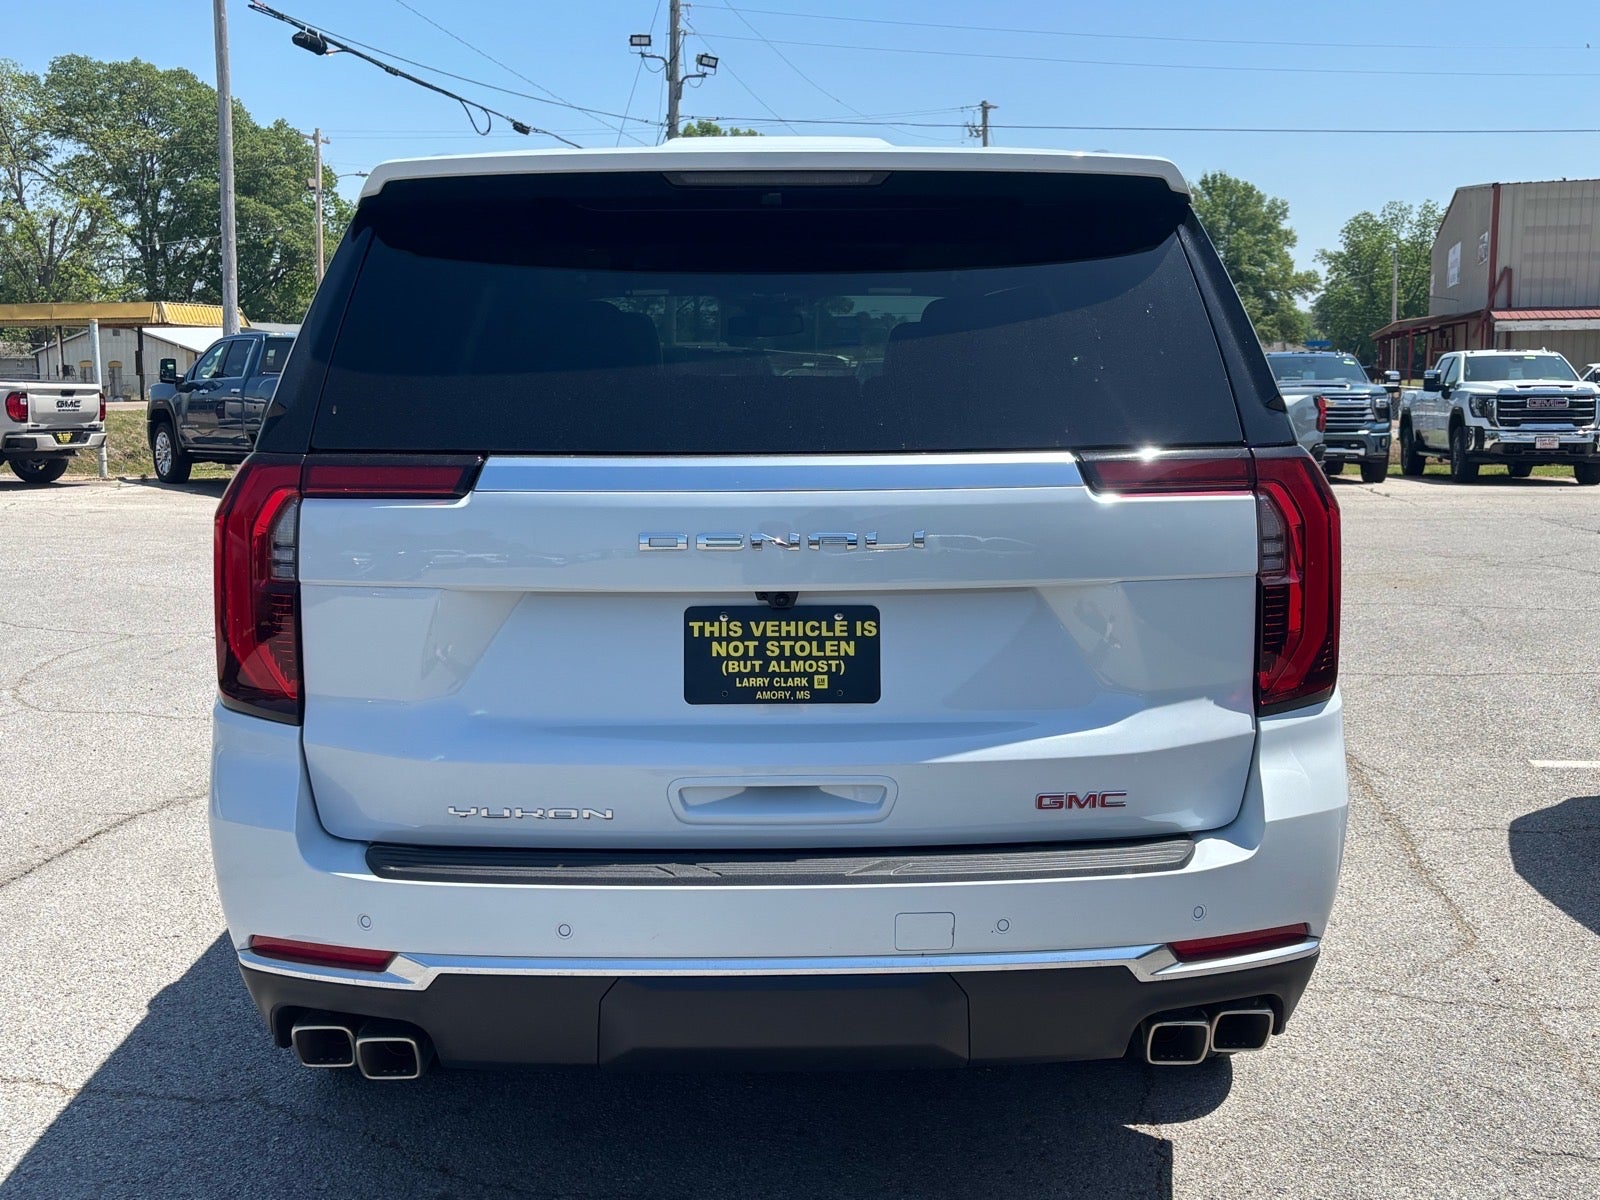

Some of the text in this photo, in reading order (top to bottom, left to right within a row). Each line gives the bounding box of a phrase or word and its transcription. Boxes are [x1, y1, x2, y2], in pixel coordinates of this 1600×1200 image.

[57, 400, 81, 408] GMC
[1530, 399, 1567, 407] GMC
[639, 531, 925, 551] DENALI
[689, 621, 877, 637] THIS VEHICLE IS
[711, 641, 855, 656] NOT STOLEN
[722, 660, 845, 676] (BUT ALMOST)
[736, 678, 769, 687] LARRY
[773, 677, 808, 687] CLARK
[756, 691, 811, 700] AMORY, MS
[1035, 790, 1127, 810] GMC
[448, 805, 613, 820] YUKON
